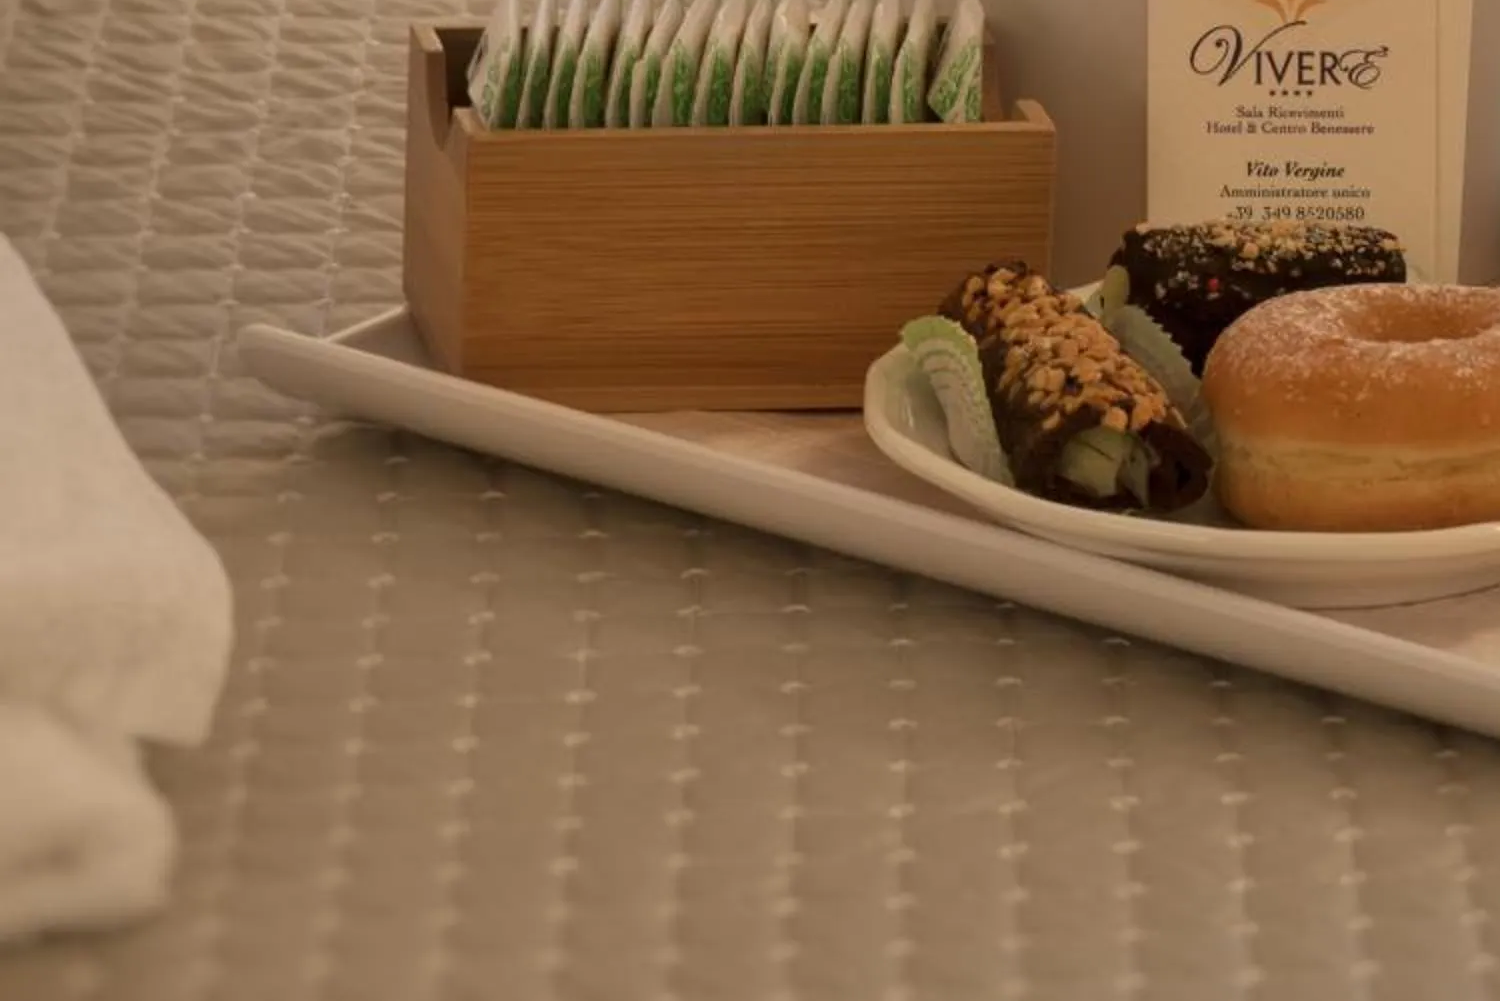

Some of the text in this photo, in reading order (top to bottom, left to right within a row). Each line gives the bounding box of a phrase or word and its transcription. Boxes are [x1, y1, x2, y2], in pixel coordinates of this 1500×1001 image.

[1189, 20, 1391, 90] VIVERE
[1235, 106, 1345, 119] Sala Ricevimenti
[1206, 121, 1243, 134] Hotel
[1261, 121, 1306, 134] Centro
[1311, 121, 1375, 135] Benessere
[1246, 161, 1345, 181] Vito Vergine
[1220, 185, 1371, 199] Amministratore unico
